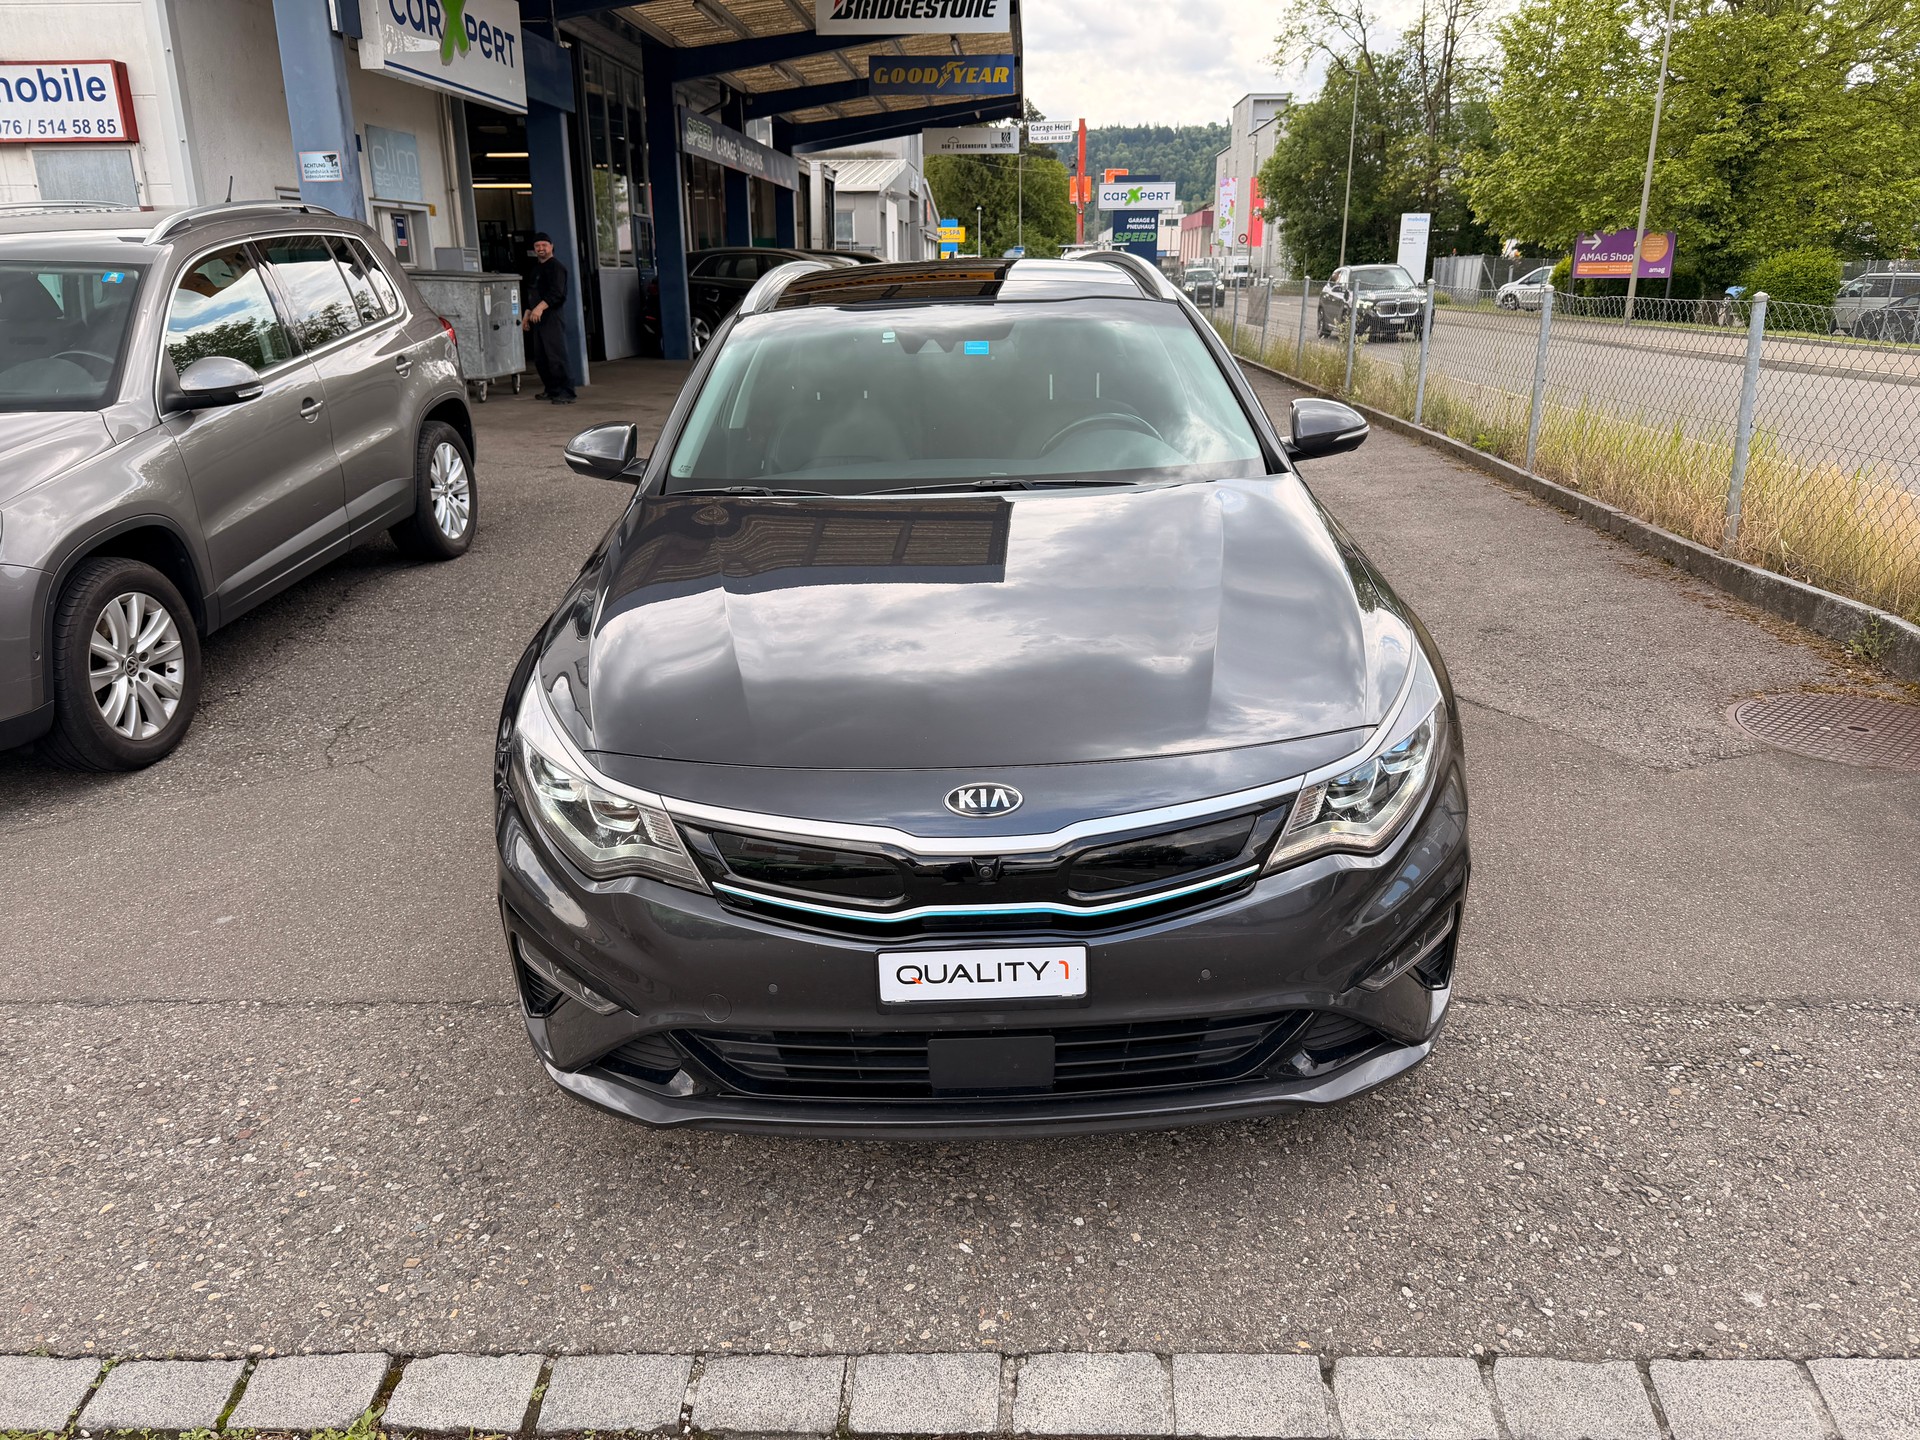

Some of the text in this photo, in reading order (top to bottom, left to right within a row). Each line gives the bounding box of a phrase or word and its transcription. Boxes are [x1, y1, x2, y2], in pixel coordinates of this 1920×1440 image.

[830, 0, 997, 20] BRIDGESTONE
[0, 119, 22, 134] 76
[38, 119, 67, 134] 514
[73, 119, 91, 134] 58
[96, 118, 117, 134] 85
[686, 117, 713, 151] SPEED
[1030, 124, 1053, 133] Garage
[1113, 232, 1157, 242] SPEED
[1580, 253, 1634, 262] AMAG Shop
[958, 788, 1011, 808] KIA
[896, 960, 1051, 985] QUALITY
